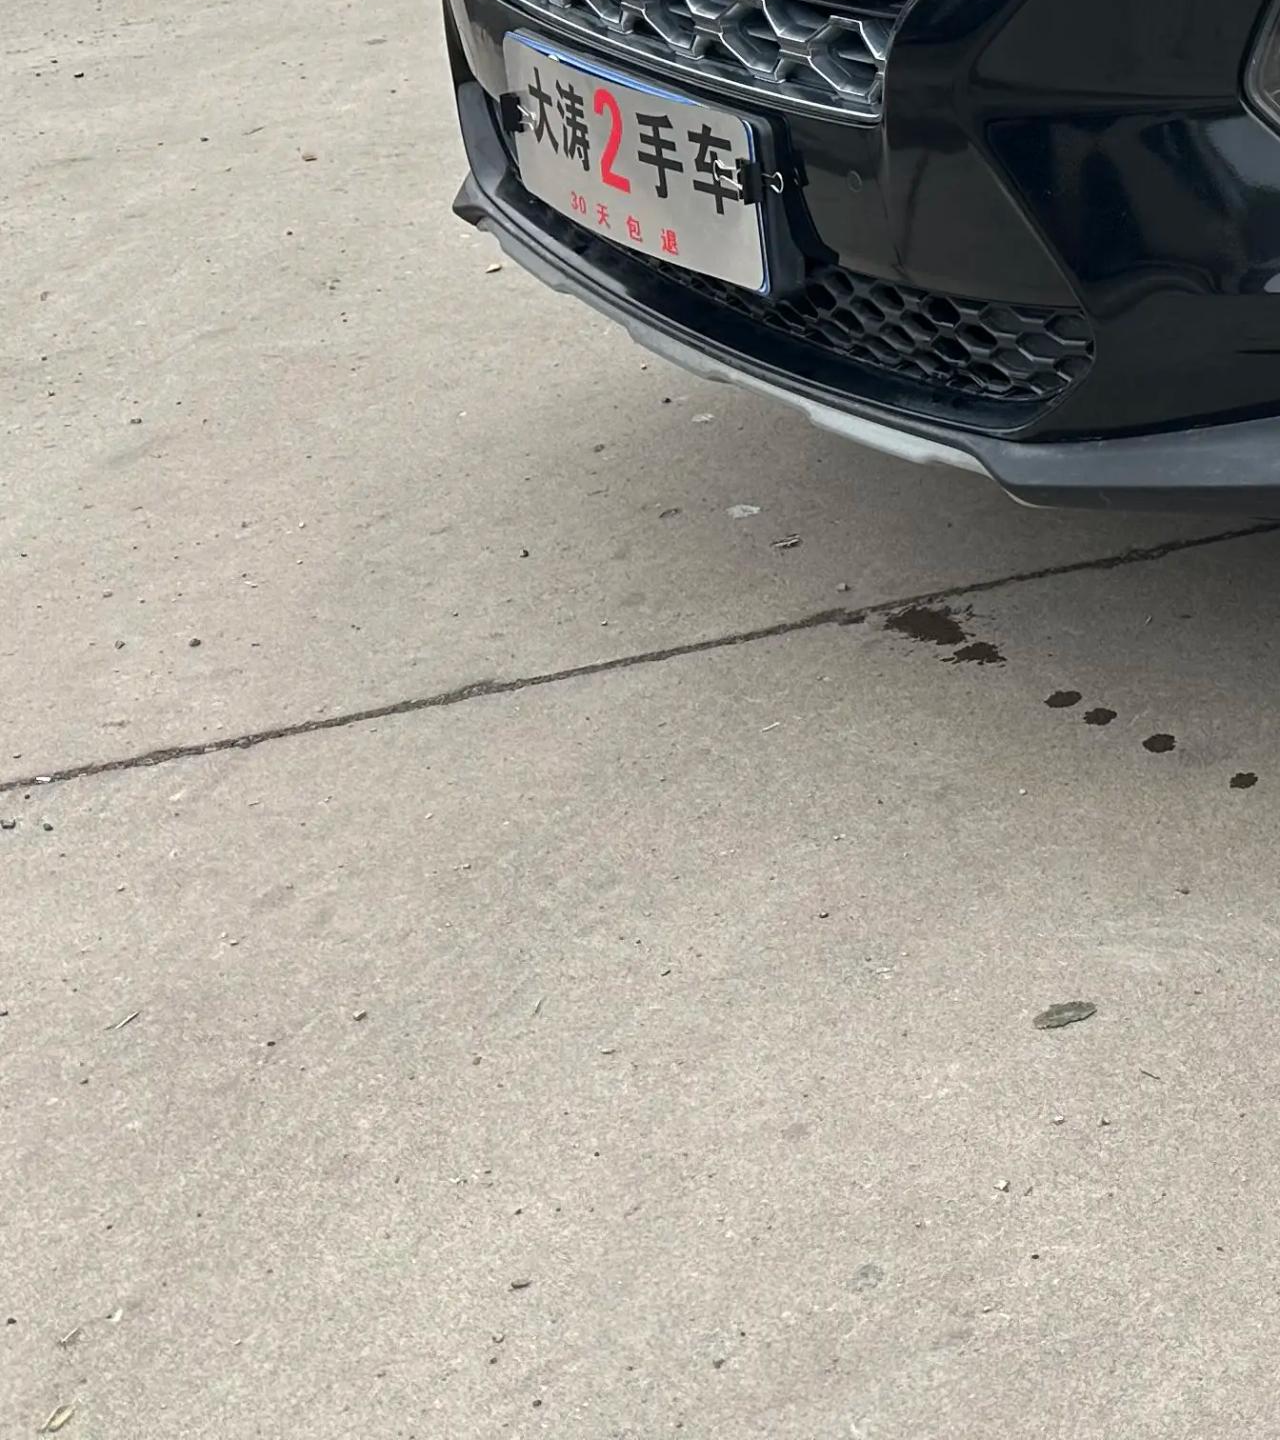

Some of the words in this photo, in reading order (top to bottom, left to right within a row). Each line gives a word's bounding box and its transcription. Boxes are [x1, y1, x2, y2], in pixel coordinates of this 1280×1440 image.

[527, 66, 740, 215] 大涛2手车
[570, 191, 679, 255] 30天包退
